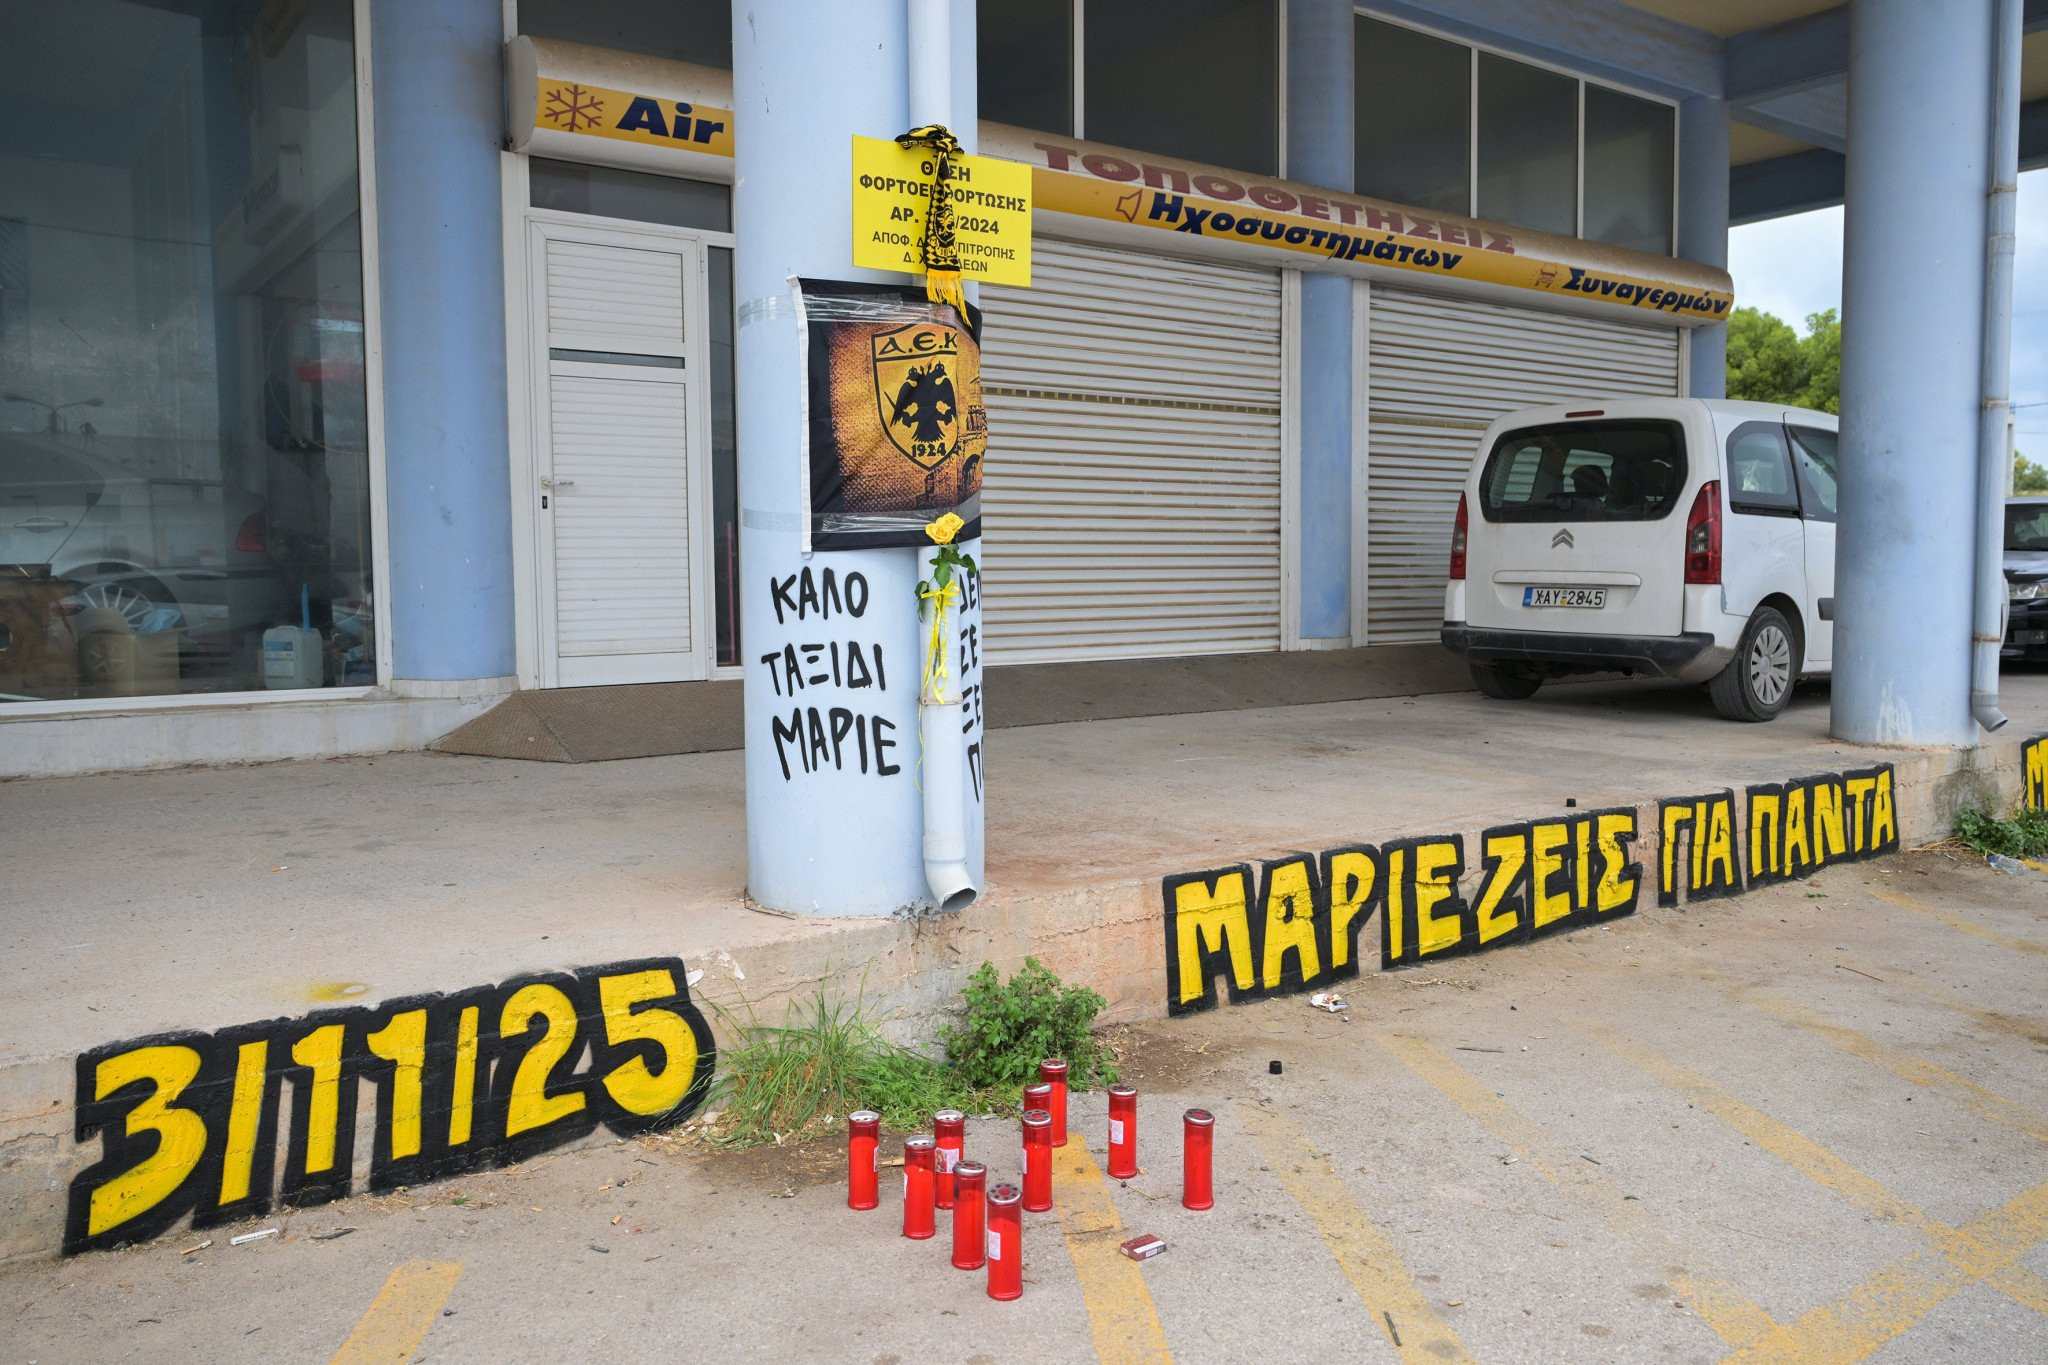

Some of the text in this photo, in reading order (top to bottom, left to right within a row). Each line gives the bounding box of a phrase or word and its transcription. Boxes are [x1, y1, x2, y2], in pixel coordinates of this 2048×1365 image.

[616, 96, 725, 144] Air
[859, 174, 1026, 212] ΦΟΡΤΟΕΟΡΤΩΣΗΣ
[921, 160, 971, 182] ΘΣΗ
[890, 206, 919, 223] ΑΡ.
[1033, 142, 1516, 255] ΤΟΠΟΘΕΤΗΣΕΙΣ
[872, 231, 913, 246] ΑΠΟΦ.
[955, 241, 1015, 260] ΠΙΤΡΟΠΗΣ
[1147, 192, 1463, 270] Ηχοσυστημάτων
[903, 251, 915, 263] Δ.
[1562, 267, 1729, 314] Συναγερμών
[911, 442, 947, 458] 1924
[770, 566, 869, 624] ΚΑΛΟ
[761, 640, 887, 697] ΤΑΞΙΔΙ
[772, 706, 901, 782] ΜΑΡΙΕ
[1168, 766, 1896, 1010] ΜΑΡΙΕ ΖΕΙΣ ΓΙΑ ΠΑΝΤΑ
